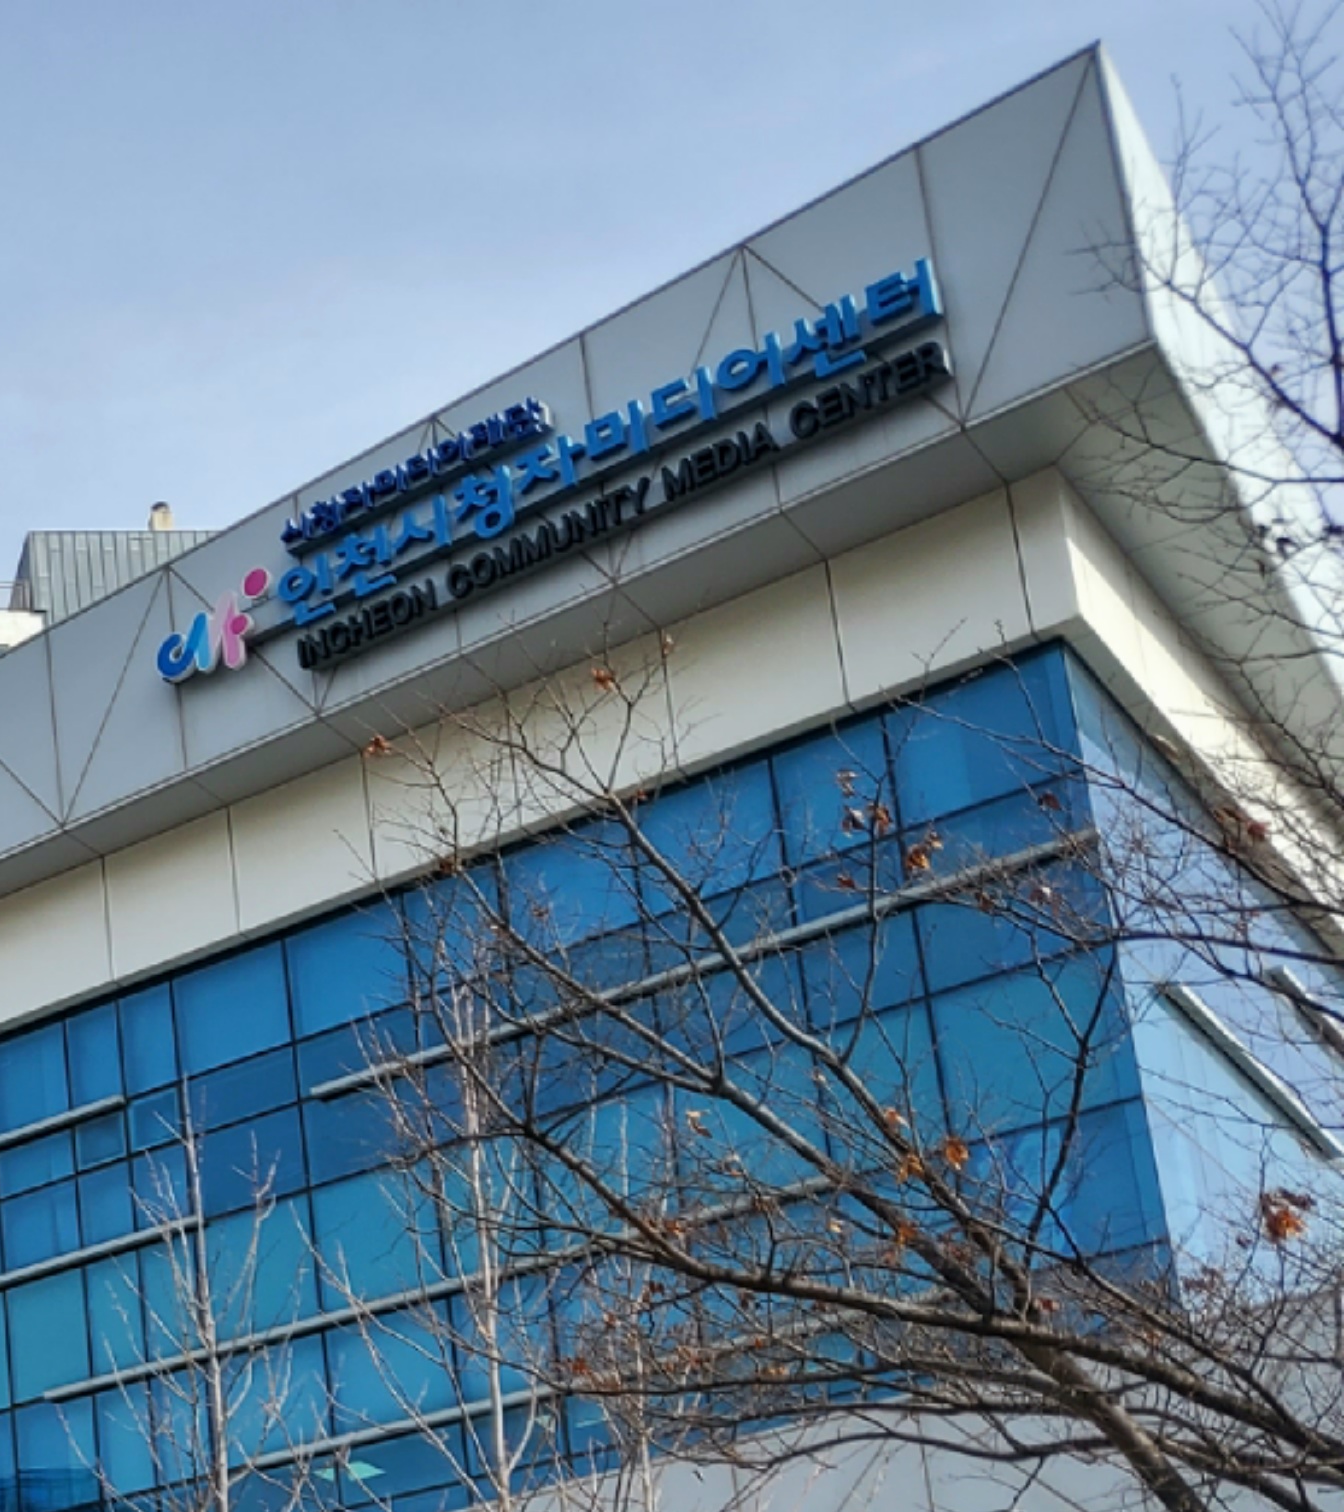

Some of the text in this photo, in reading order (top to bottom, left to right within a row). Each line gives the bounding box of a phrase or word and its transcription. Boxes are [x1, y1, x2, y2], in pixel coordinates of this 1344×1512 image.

[279, 257, 942, 625] 인천시청자미디어센터
[281, 397, 553, 542] 시청자미디어재단
[297, 342, 951, 670] INCHEON COMMUNITY MEDIA CENTER
